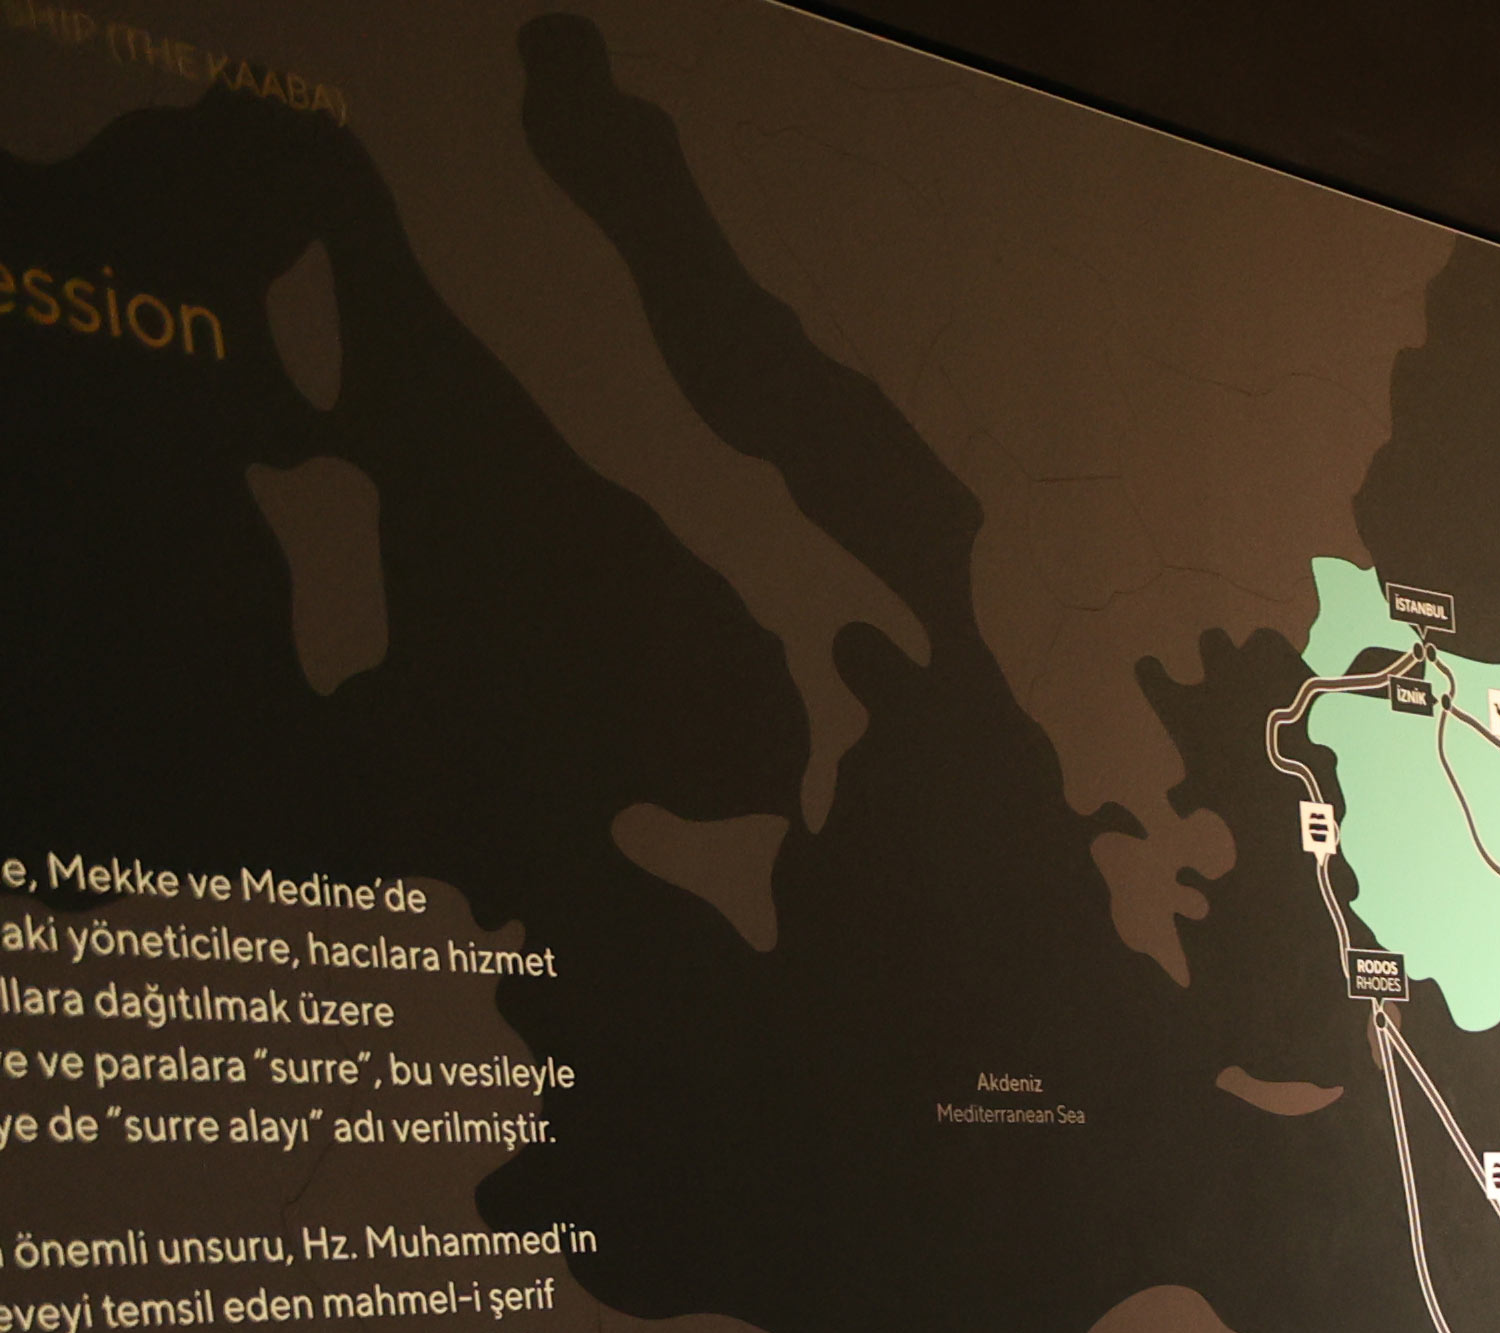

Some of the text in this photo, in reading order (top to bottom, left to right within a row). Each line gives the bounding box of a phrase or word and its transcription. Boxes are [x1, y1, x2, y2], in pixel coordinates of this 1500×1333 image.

[1394, 593, 1449, 620] İSTANBUL
[1396, 684, 1427, 706] İZNİK
[0, 859, 37, 892] e,
[48, 852, 179, 897] Mekke
[188, 873, 231, 900] ve
[68, 920, 299, 969] yöneticilere,
[308, 932, 440, 971] hacılara
[448, 940, 557, 977] hizmet
[1356, 959, 1399, 975] RODOS
[95, 982, 290, 1028] dağıtılmak
[299, 992, 394, 1027] üzere
[1356, 975, 1401, 992] RHODES
[38, 1052, 83, 1079] ve
[95, 1046, 246, 1088] paralara
[390, 1053, 432, 1085] bu
[440, 1055, 574, 1096] vesileyle
[977, 1072, 1043, 1093] Akdeniz
[49, 1106, 98, 1142] de
[335, 1110, 384, 1142] adı
[392, 1111, 555, 1151] verilmiştir.
[937, 1103, 1086, 1125] Mediterranean Sea
[15, 1230, 148, 1268] önemli
[159, 1237, 293, 1265] unsuru,
[303, 1227, 357, 1259] Hz.
[366, 1223, 596, 1258] Muhammed'in
[102, 1290, 213, 1328] temsil
[224, 1288, 313, 1322] eden
[323, 1281, 481, 1318] mahmel-i
[489, 1278, 554, 1319] şerif
